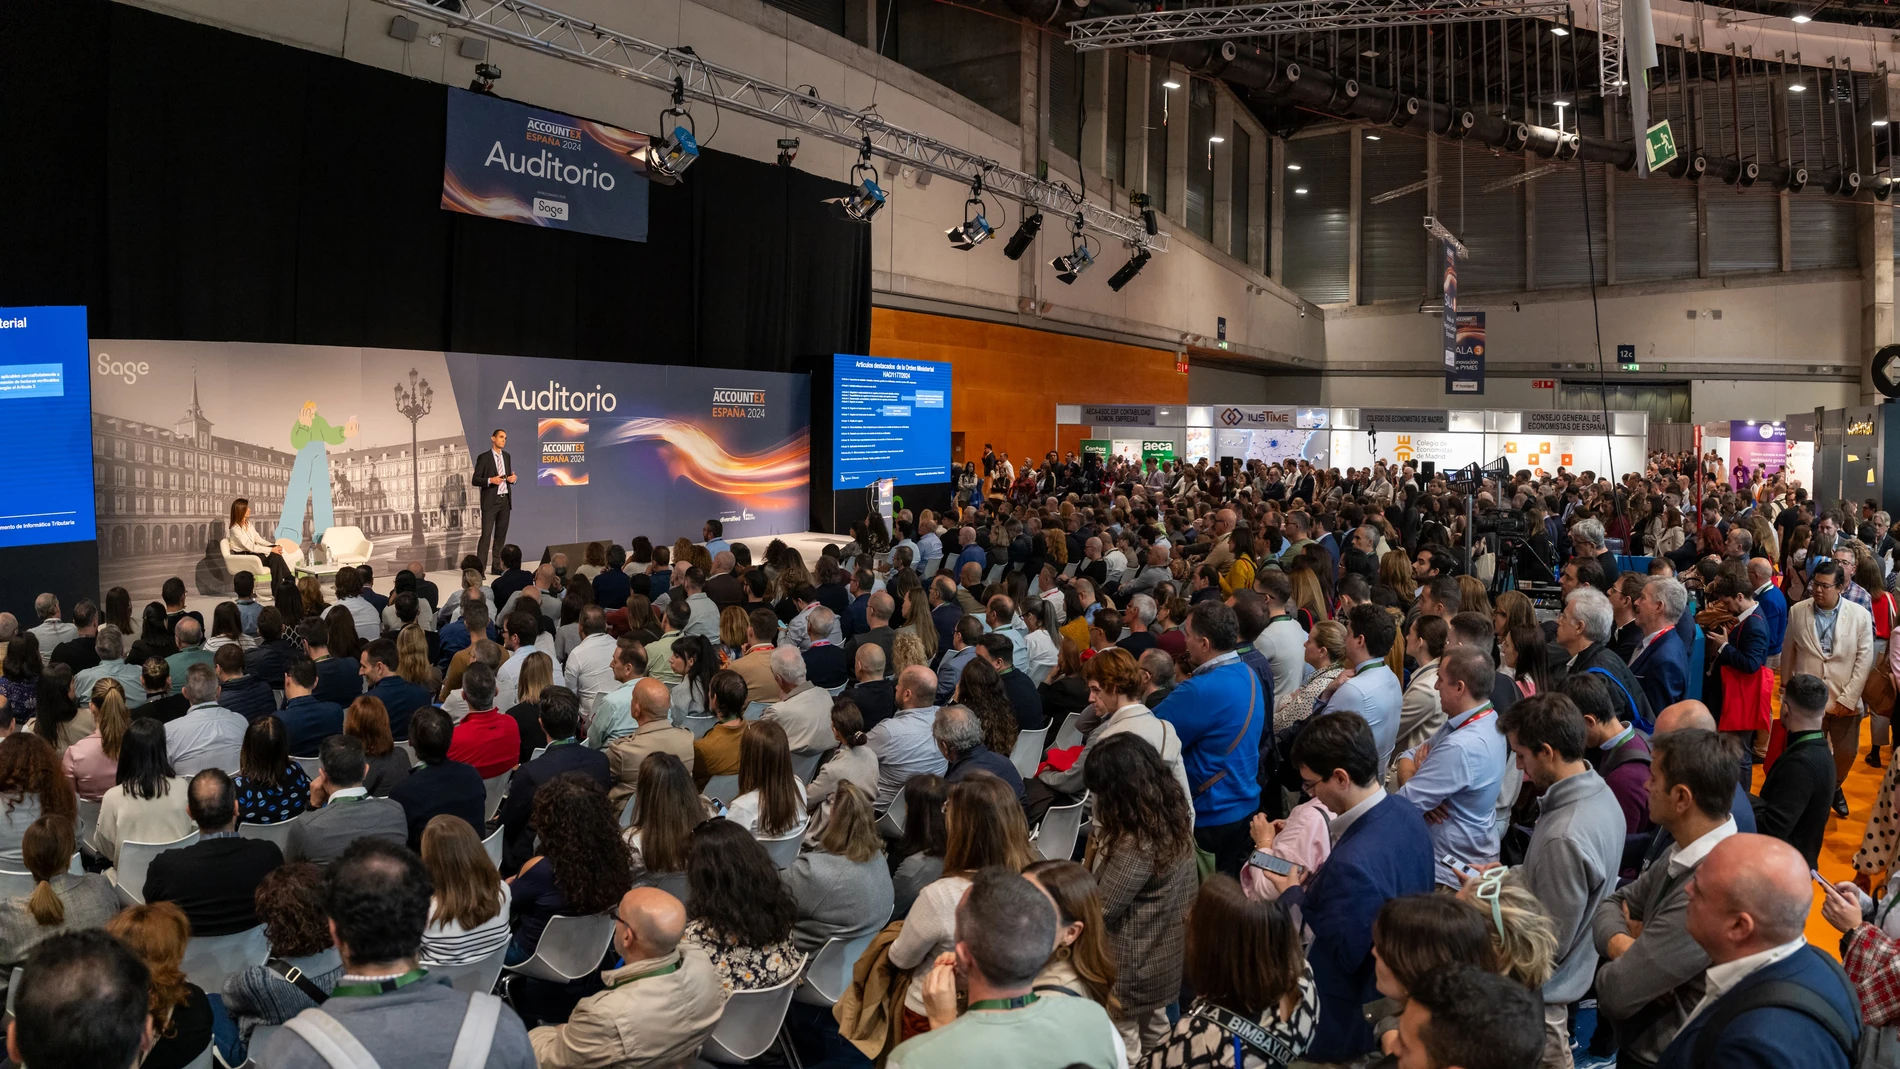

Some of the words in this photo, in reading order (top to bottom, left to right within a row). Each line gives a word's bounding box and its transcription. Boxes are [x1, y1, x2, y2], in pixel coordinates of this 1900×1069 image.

[527, 119, 582, 140] ACCOUNTEX
[526, 131, 560, 147] ESPAÑA
[562, 140, 581, 151] 2024
[484, 141, 615, 191] Auditorio
[538, 200, 563, 218] Sage
[1456, 345, 1473, 355] ALA
[1476, 345, 1482, 354] 3
[1620, 350, 1632, 358] 12c
[97, 352, 150, 385] Sage
[498, 381, 617, 413] Auditorio
[713, 390, 765, 404] ACCOUNTEX
[712, 406, 746, 418] ESPAÑA
[747, 408, 765, 418] 2024
[1532, 413, 1560, 422] CONSEJO
[1562, 414, 1590, 422] GENERAL
[1367, 414, 1384, 422] COLEGIO
[1392, 415, 1420, 423] ECONOMISTAS
[1528, 422, 1571, 430] ECONOMISTAS
[1582, 421, 1605, 431] ESPAÑA
[543, 443, 585, 453] ACCOUNTEX
[1144, 442, 1172, 451] aeca
[542, 453, 569, 463] ESPAÑA
[570, 454, 585, 463] 2024
